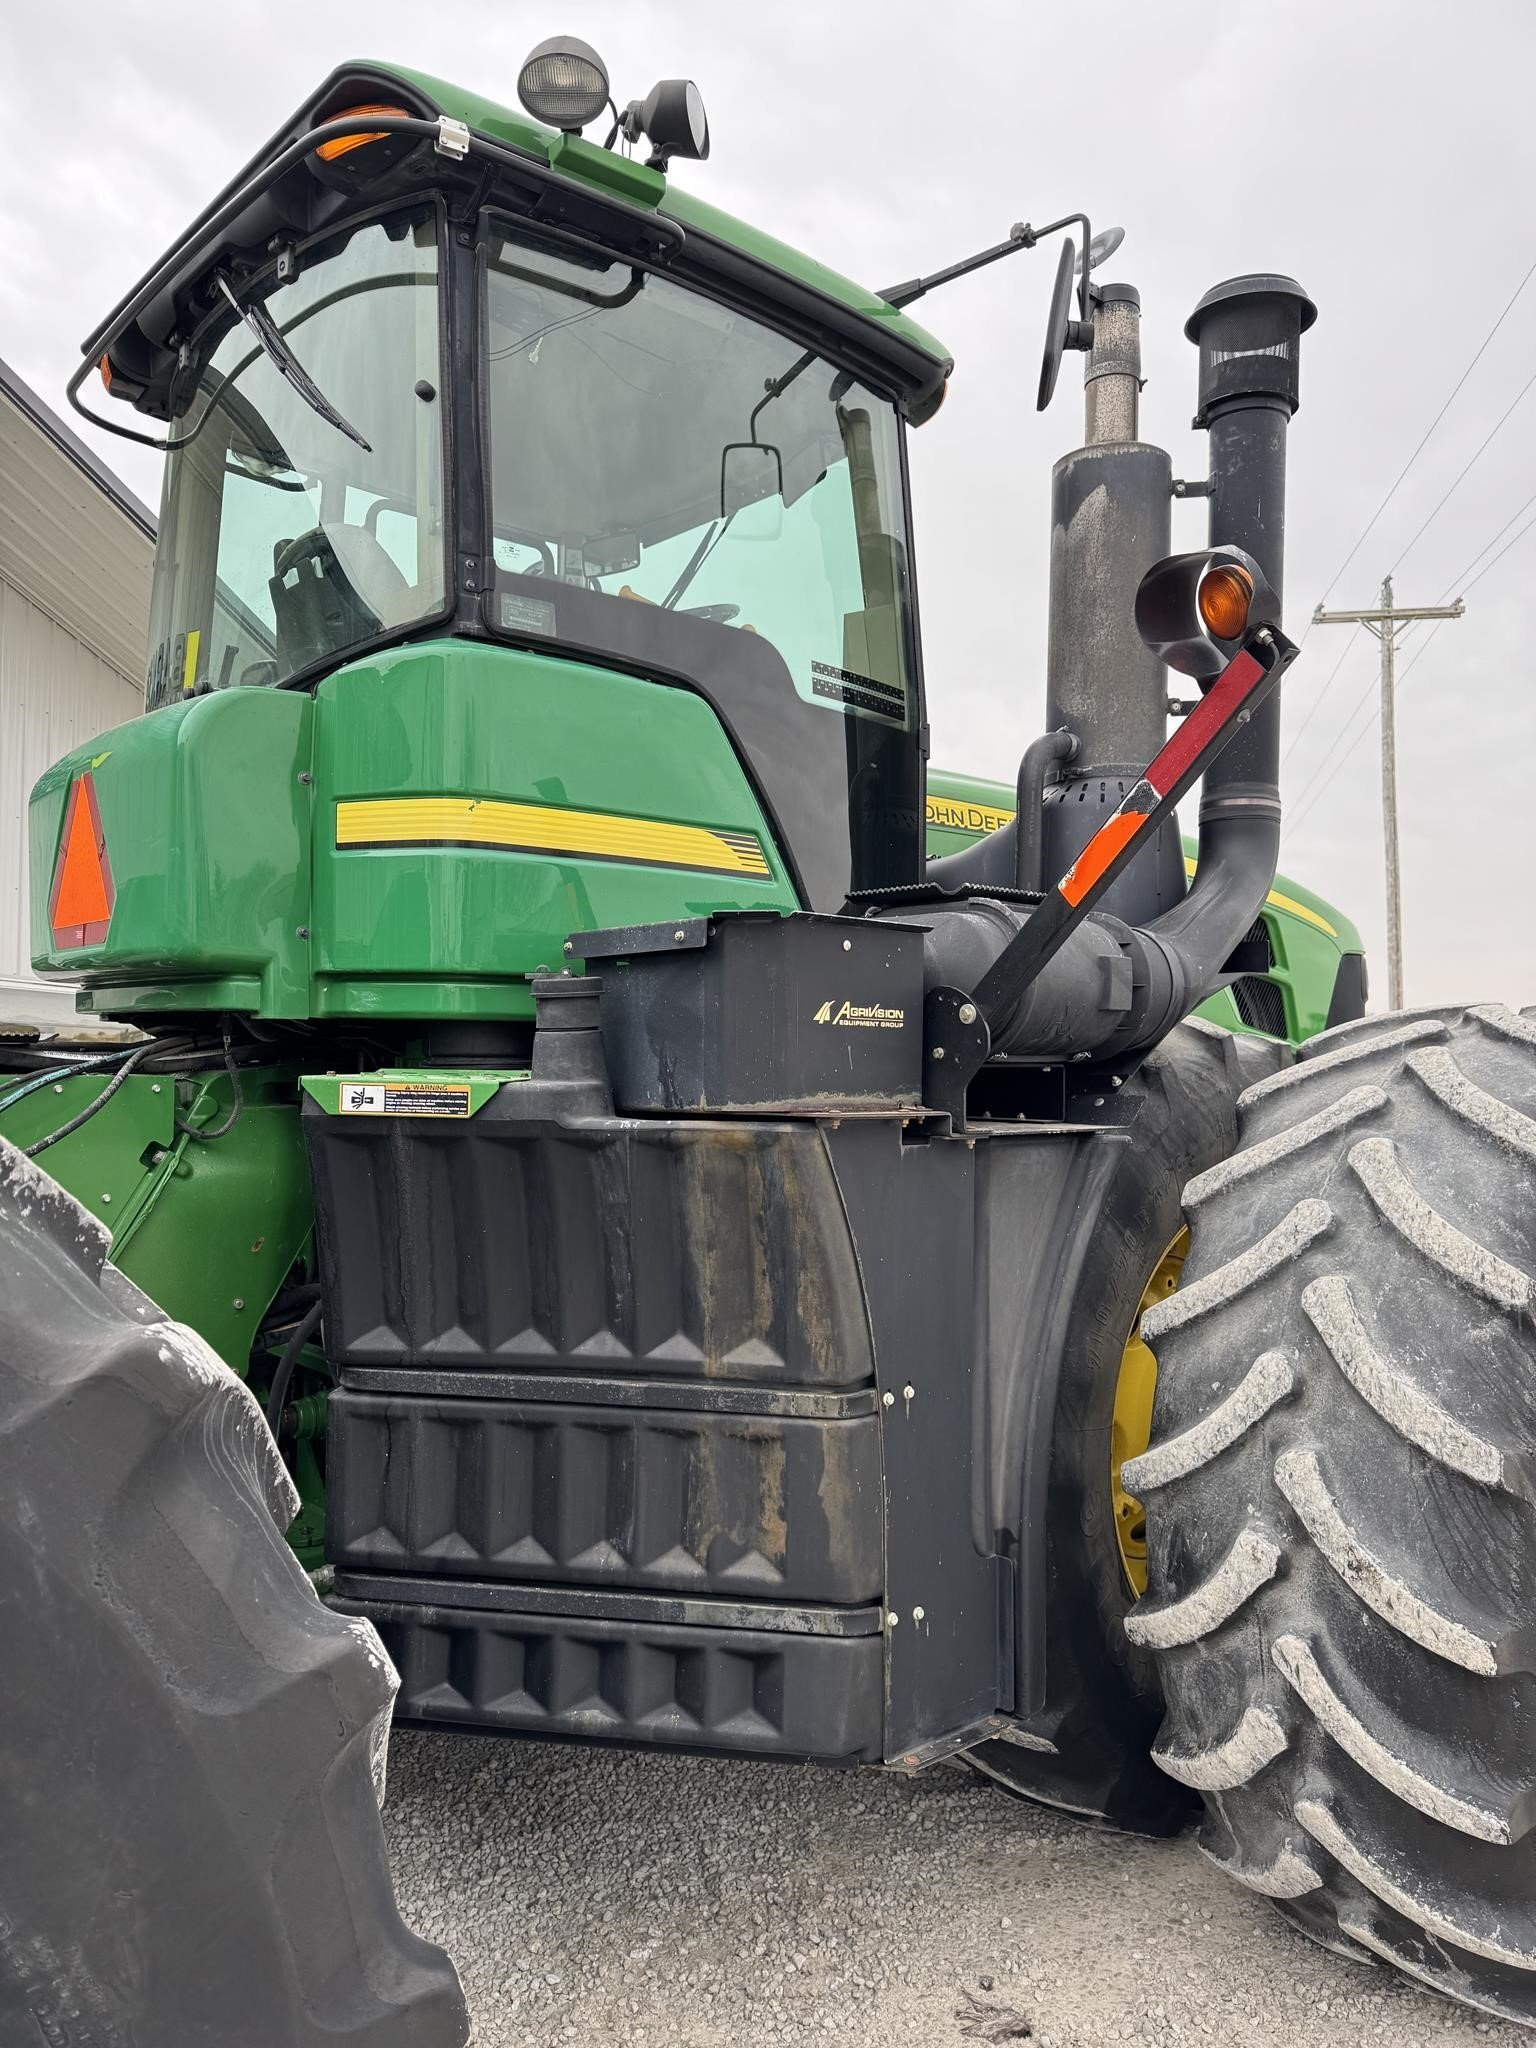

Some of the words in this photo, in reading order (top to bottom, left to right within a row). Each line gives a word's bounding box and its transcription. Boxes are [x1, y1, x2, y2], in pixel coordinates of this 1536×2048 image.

[926, 804, 964, 825] OHN
[968, 808, 1012, 831] DEE
[839, 1019, 879, 1028] EQUIPMENT
[880, 1021, 904, 1029] GROUP
[412, 1084, 448, 1092] WARNING
